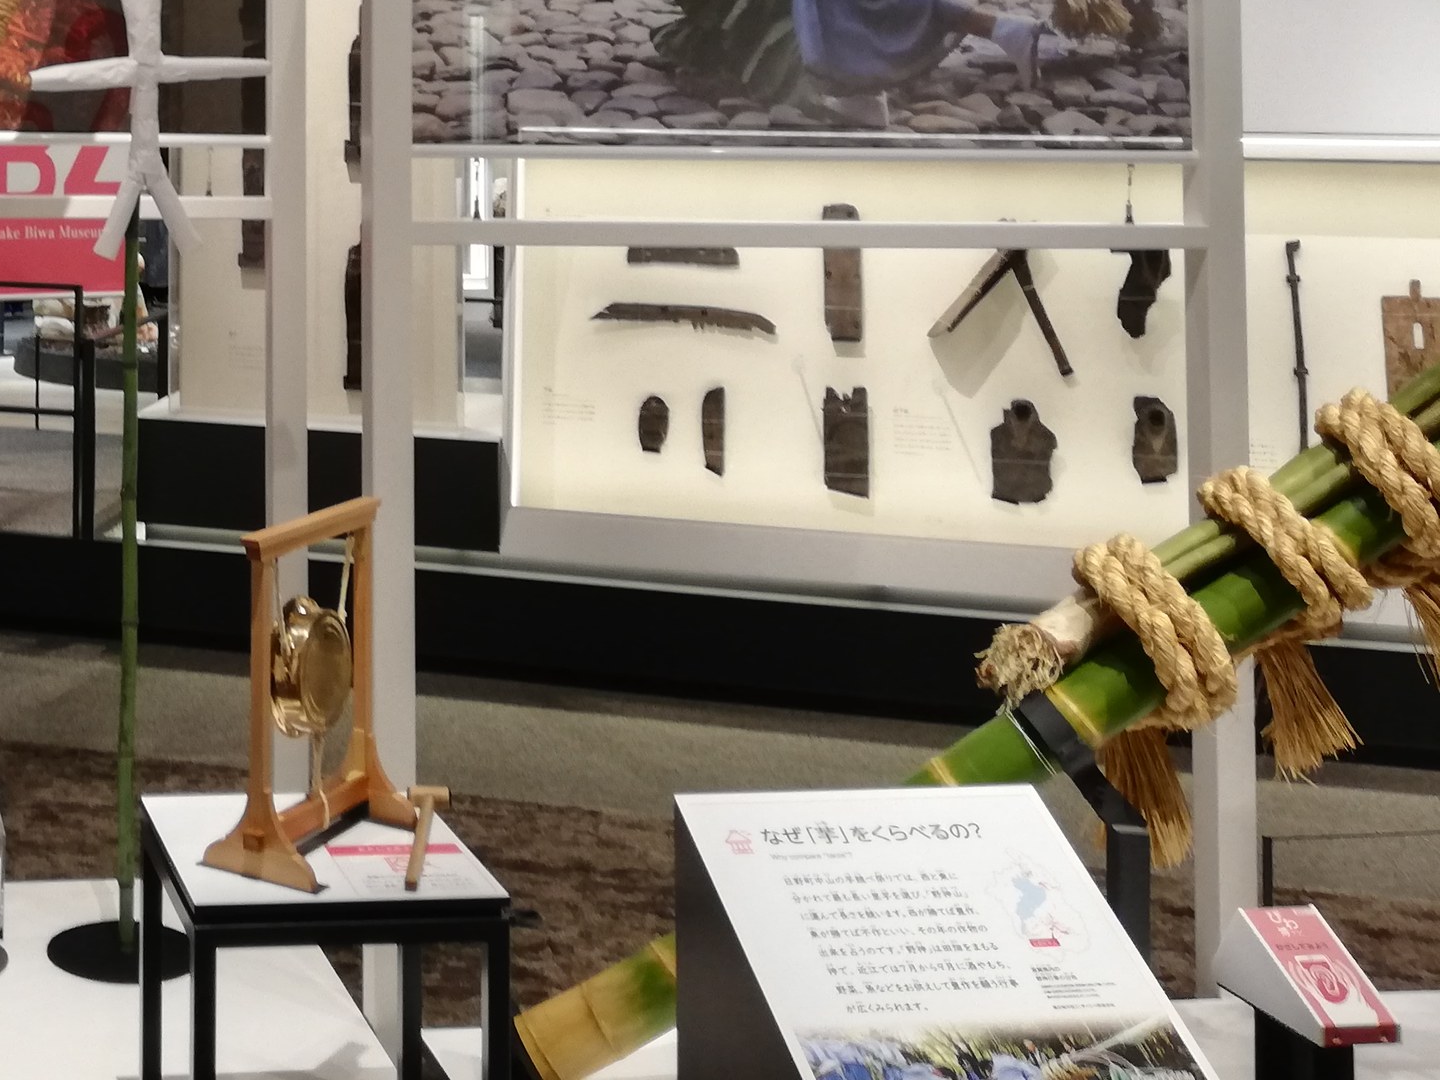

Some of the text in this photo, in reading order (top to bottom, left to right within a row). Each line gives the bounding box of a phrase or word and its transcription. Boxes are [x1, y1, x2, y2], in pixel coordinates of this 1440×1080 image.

[25, 226, 55, 239] Biwa
[760, 822, 983, 845] なぜ「芋」をくらべるの?
